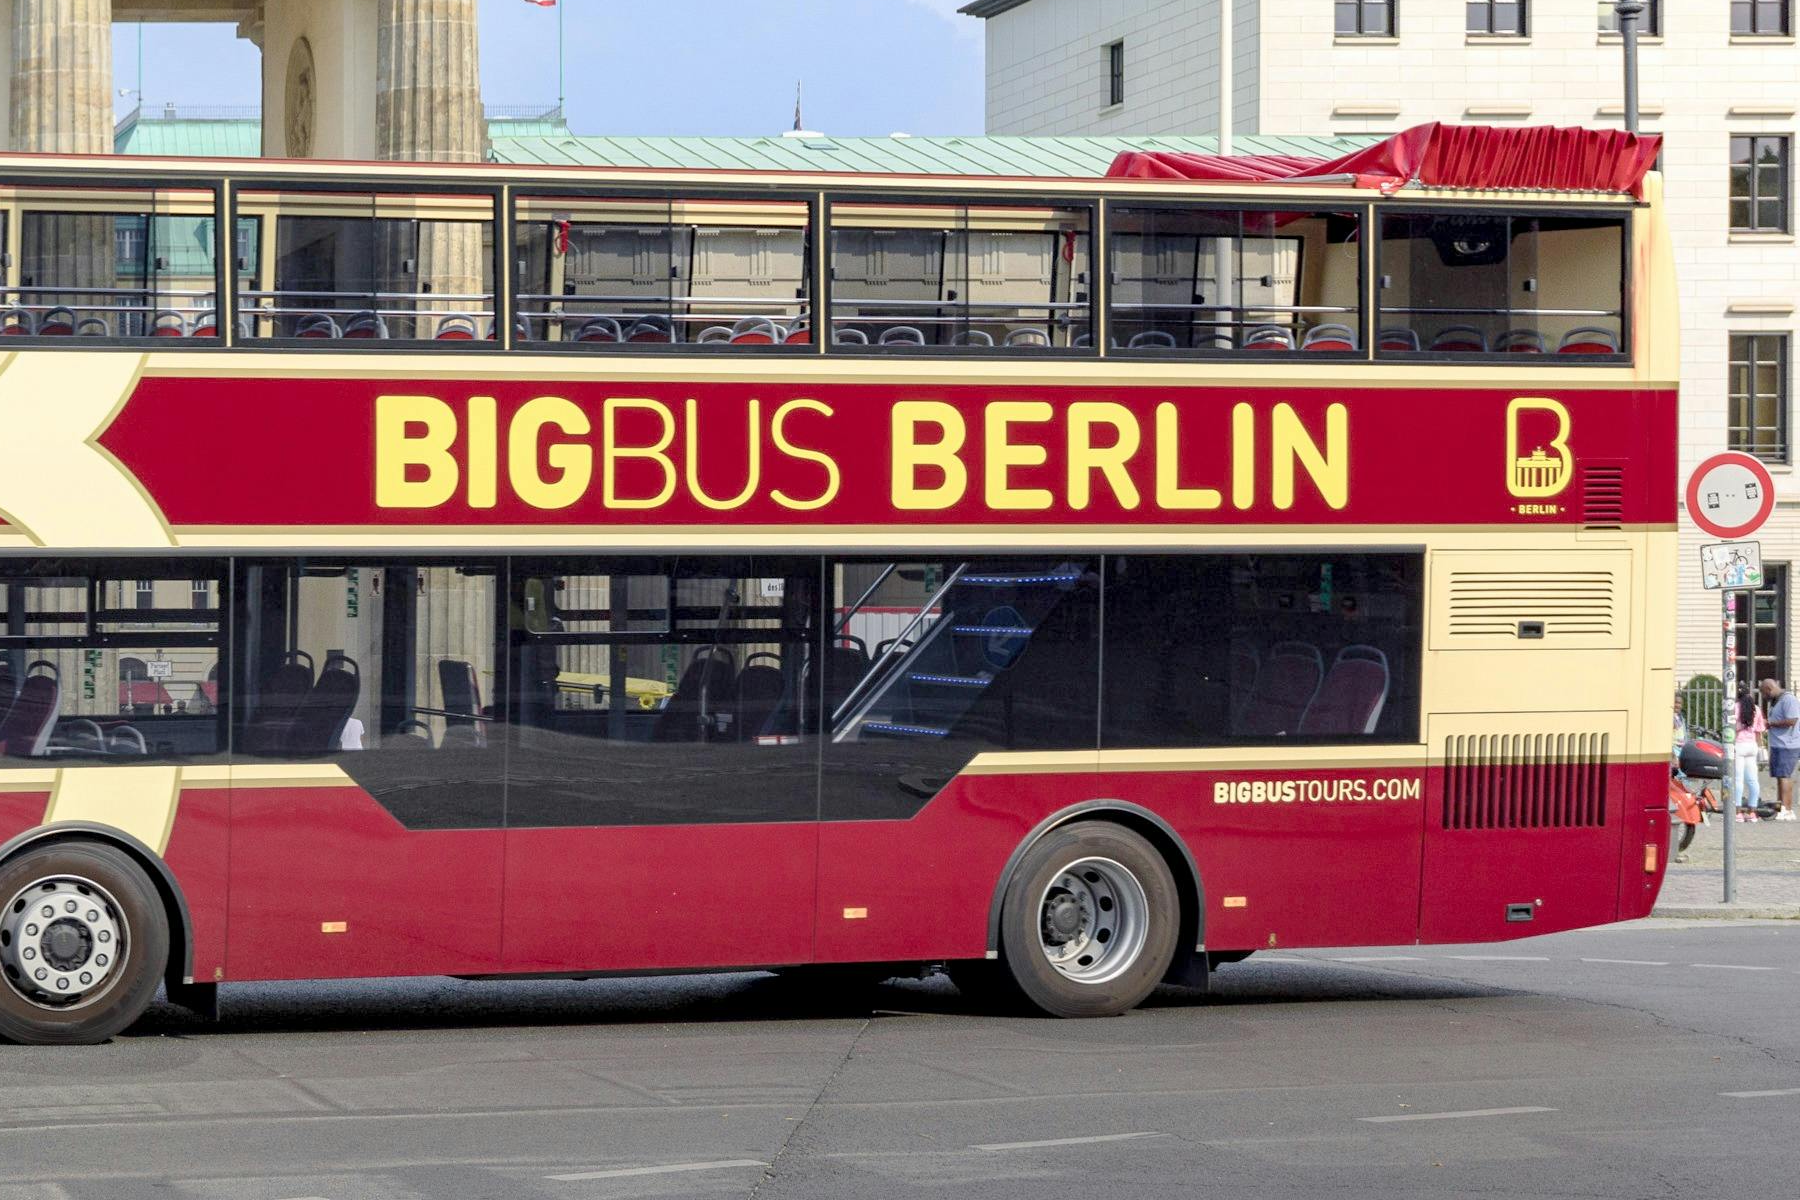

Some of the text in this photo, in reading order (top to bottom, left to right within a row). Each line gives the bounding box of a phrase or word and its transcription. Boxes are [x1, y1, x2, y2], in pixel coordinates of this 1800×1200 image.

[890, 400, 1349, 511] BERLIN
[1518, 504, 1558, 515] BERLIN
[1213, 778, 1421, 803] BIGBUSTOURS.COM
